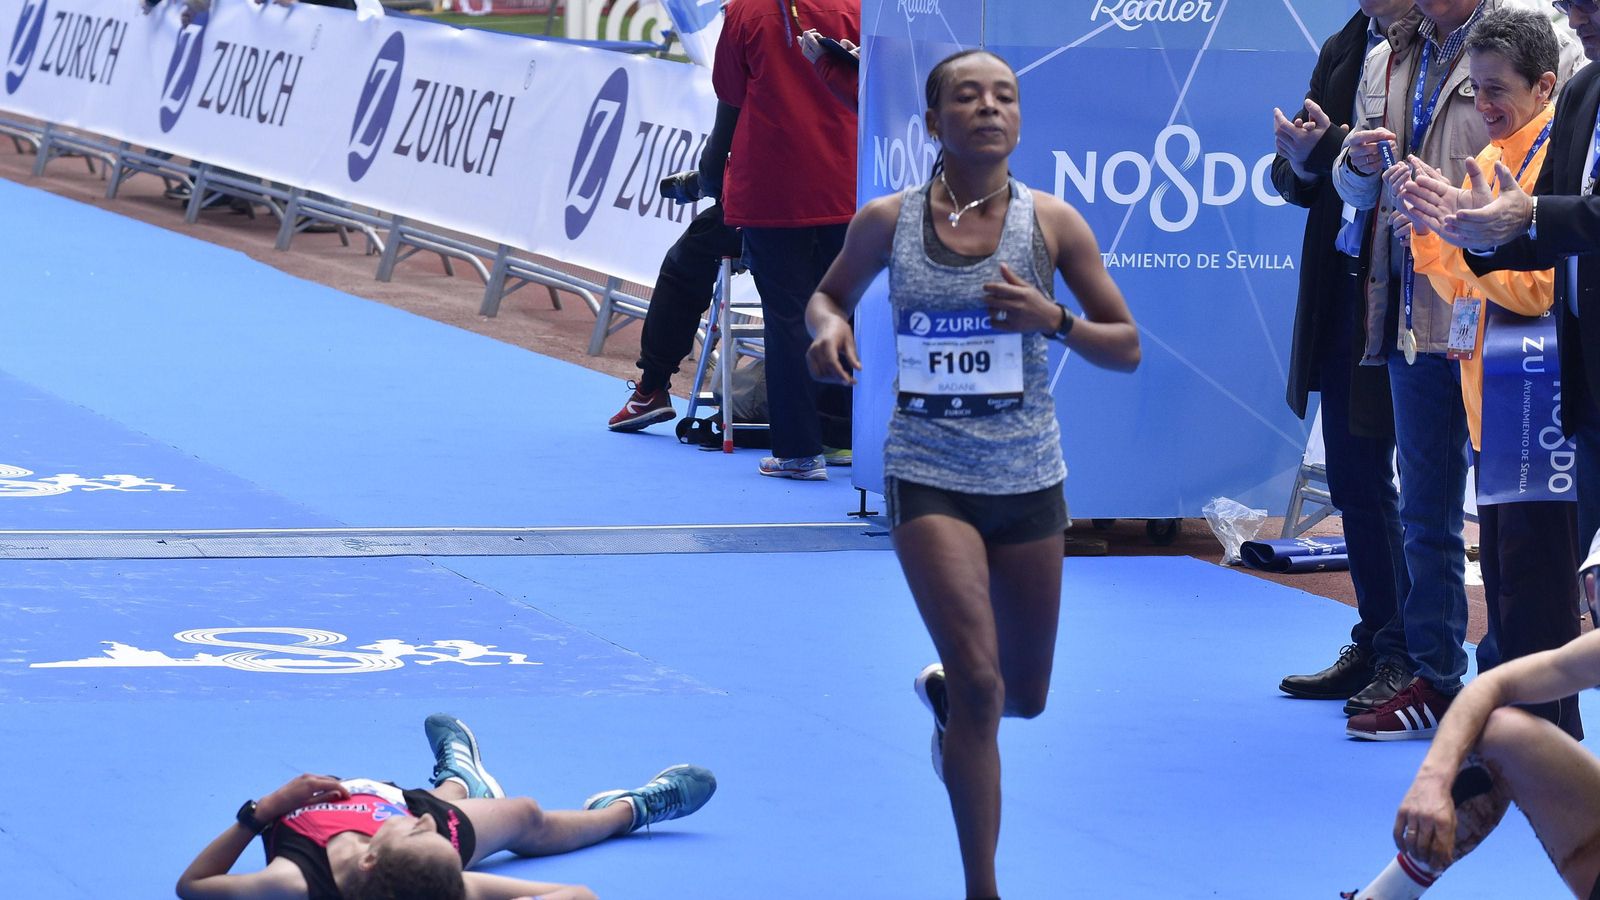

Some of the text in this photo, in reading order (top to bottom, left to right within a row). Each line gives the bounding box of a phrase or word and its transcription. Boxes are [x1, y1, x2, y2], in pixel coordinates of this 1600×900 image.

[39, 11, 128, 85] ZURICH
[197, 40, 303, 127] ZURICH
[393, 79, 515, 177] ZURICH
[874, 114, 937, 191] NO8D
[1100, 252, 1191, 269] TAMIENTO
[1196, 253, 1220, 269] DE
[935, 316, 992, 332] ZURIC
[929, 350, 991, 374] F109
